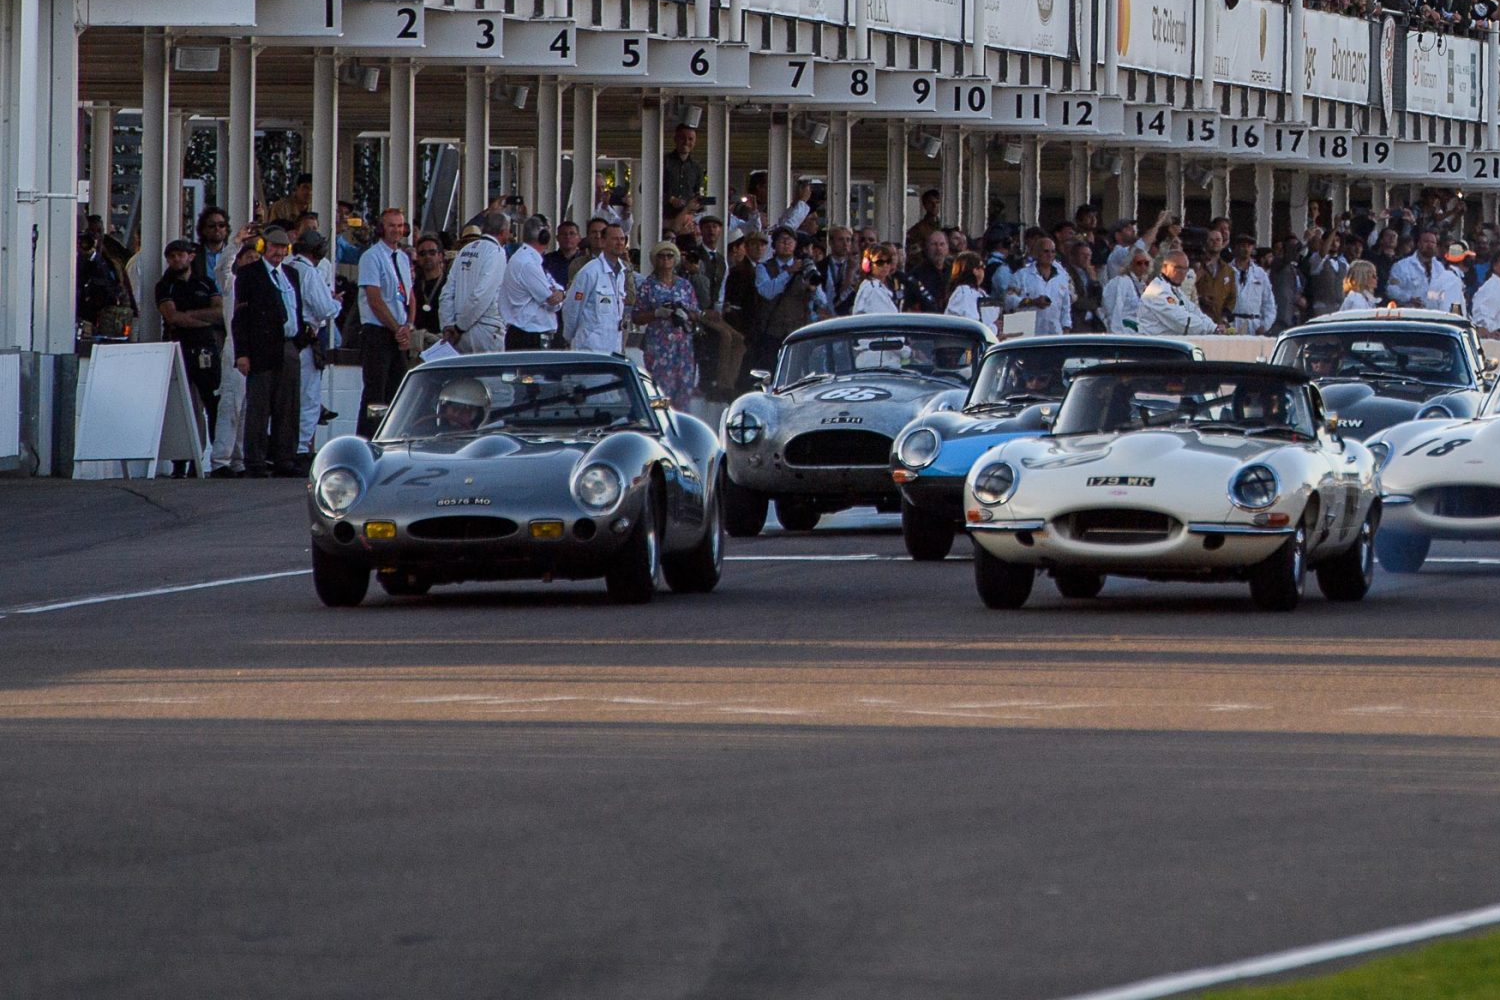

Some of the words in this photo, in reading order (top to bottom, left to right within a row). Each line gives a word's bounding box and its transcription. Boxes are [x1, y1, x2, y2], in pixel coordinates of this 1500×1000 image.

[396, 8, 418, 39] 2
[476, 19, 495, 49] 3
[549, 29, 571, 59] 4
[621, 38, 641, 67] 5
[690, 47, 709, 76] 6
[1331, 37, 1367, 85] Bonhams
[788, 61, 806, 88] 7
[850, 69, 869, 96] 8
[912, 78, 931, 104] 9
[953, 86, 986, 112] 10
[1015, 93, 1040, 119] 11
[1062, 100, 1093, 126] 12
[1136, 110, 1165, 136] 14
[1187, 117, 1215, 141] 15
[1231, 124, 1260, 148] 16
[1275, 128, 1305, 152] 17
[1319, 135, 1348, 158] 18
[1362, 141, 1390, 164] 19
[1431, 151, 1462, 173] 20
[1473, 157, 1499, 179] 21
[820, 387, 886, 402] 65
[1402, 437, 1473, 457] 18
[378, 466, 450, 487] 12
[1088, 477, 1119, 487] 179
